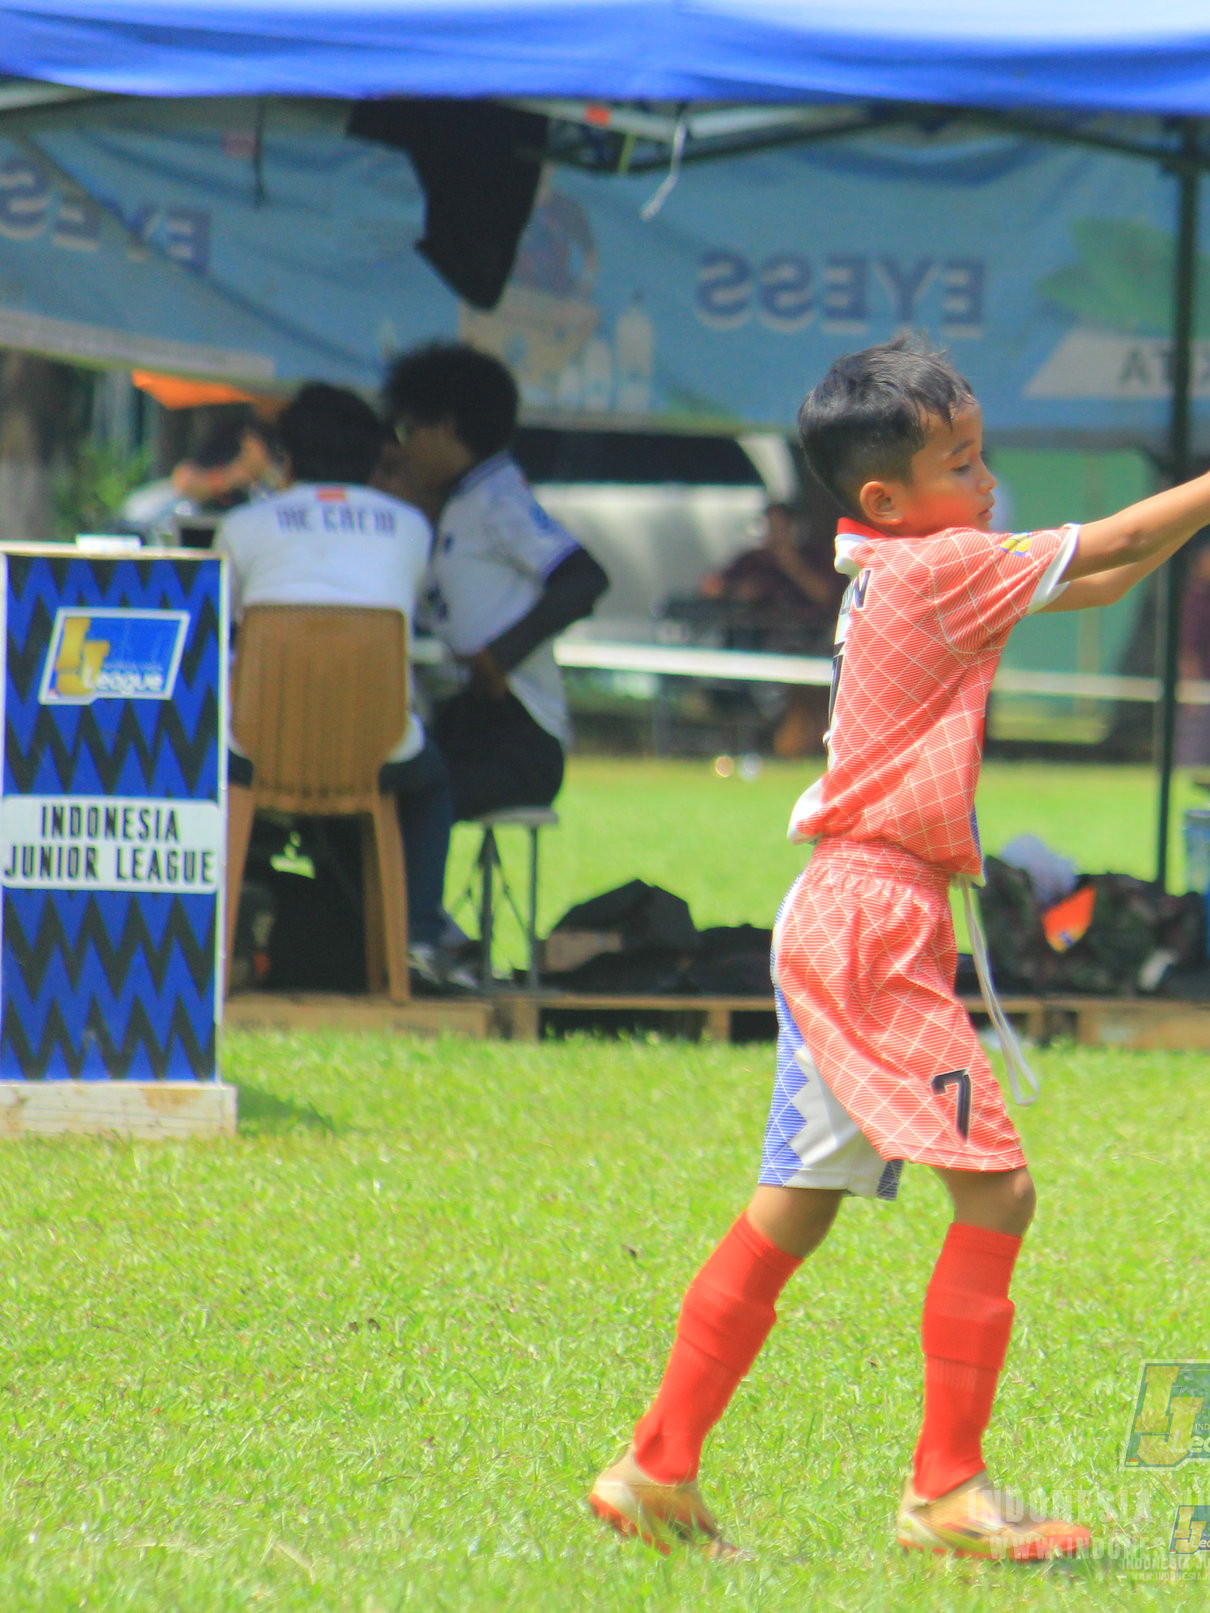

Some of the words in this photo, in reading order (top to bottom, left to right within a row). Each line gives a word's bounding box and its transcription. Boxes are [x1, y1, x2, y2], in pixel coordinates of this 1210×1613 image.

[41, 805, 180, 842] INDONESIA
[4, 845, 99, 880] JUNIOR
[116, 848, 215, 884] LEAGUE
[931, 1069, 971, 1143] 7
